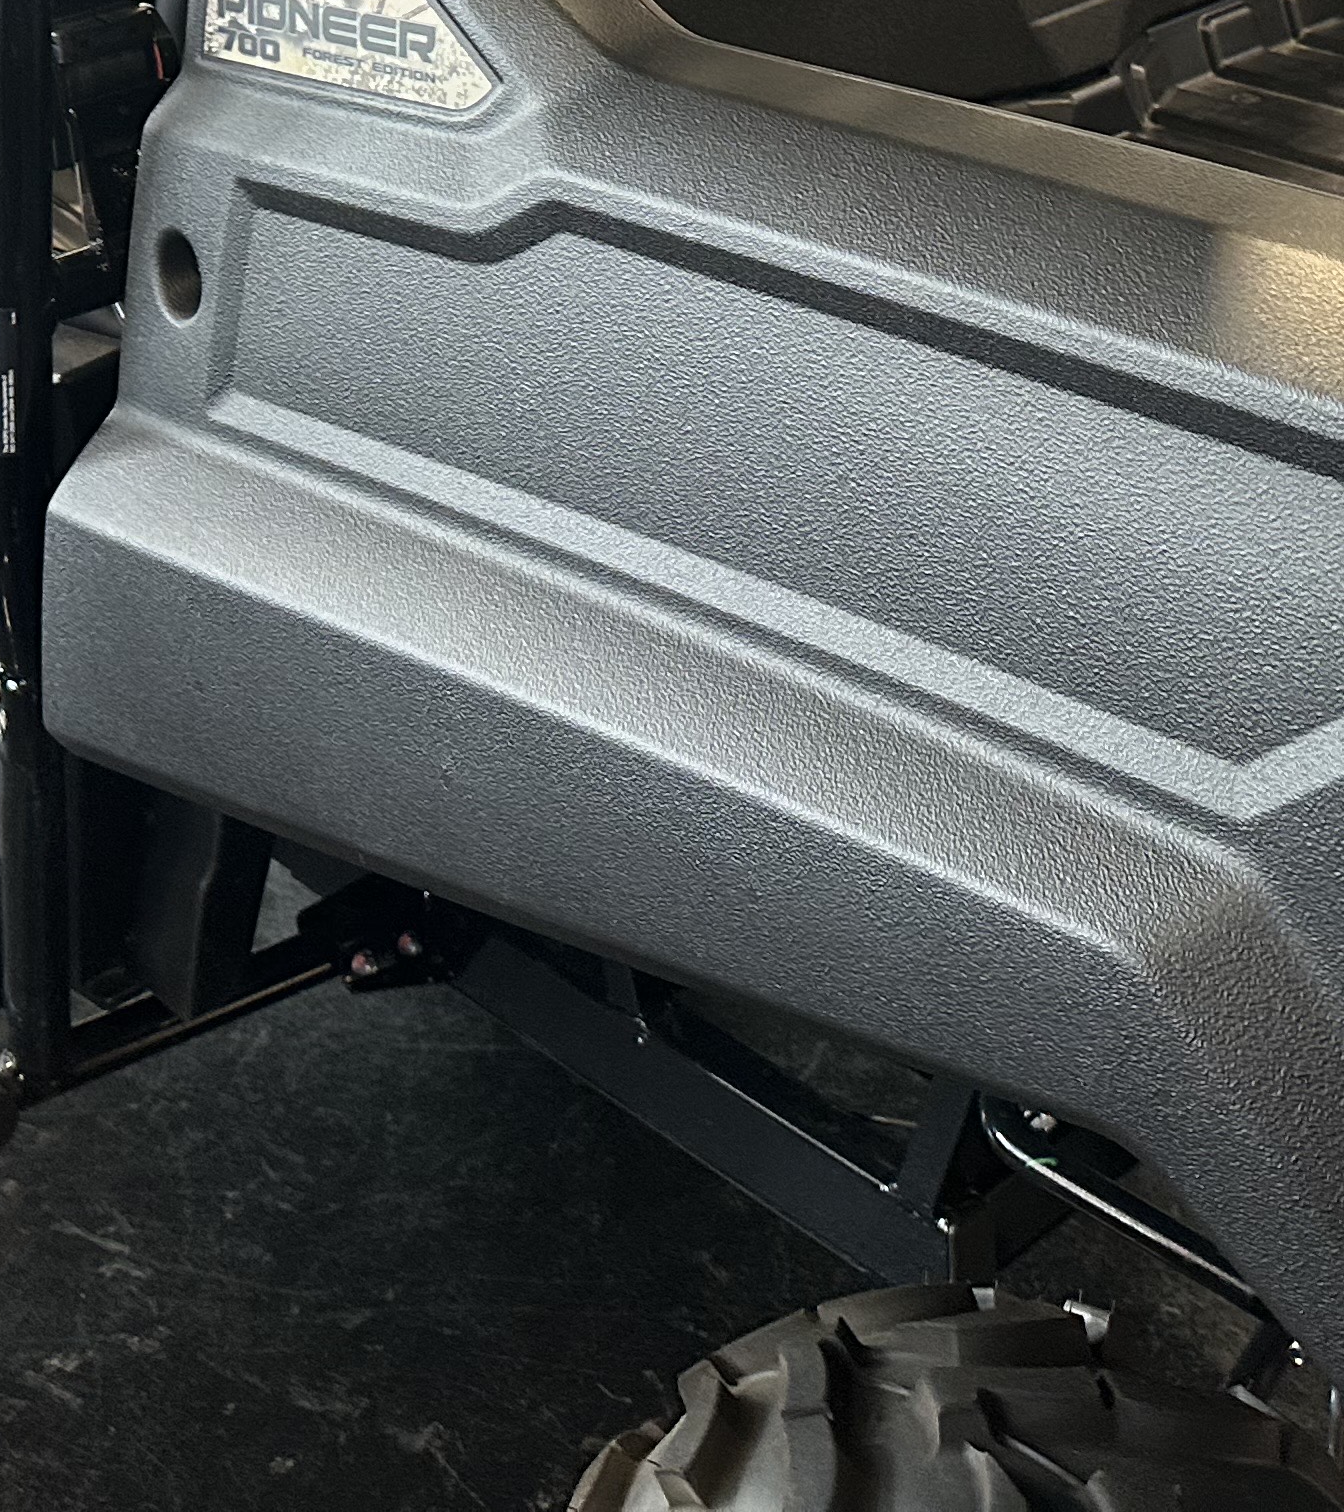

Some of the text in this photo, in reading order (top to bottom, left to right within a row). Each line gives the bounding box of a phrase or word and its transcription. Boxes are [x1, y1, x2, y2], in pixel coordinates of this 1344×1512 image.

[217, 24, 438, 84] 700 FOREST EDITION
